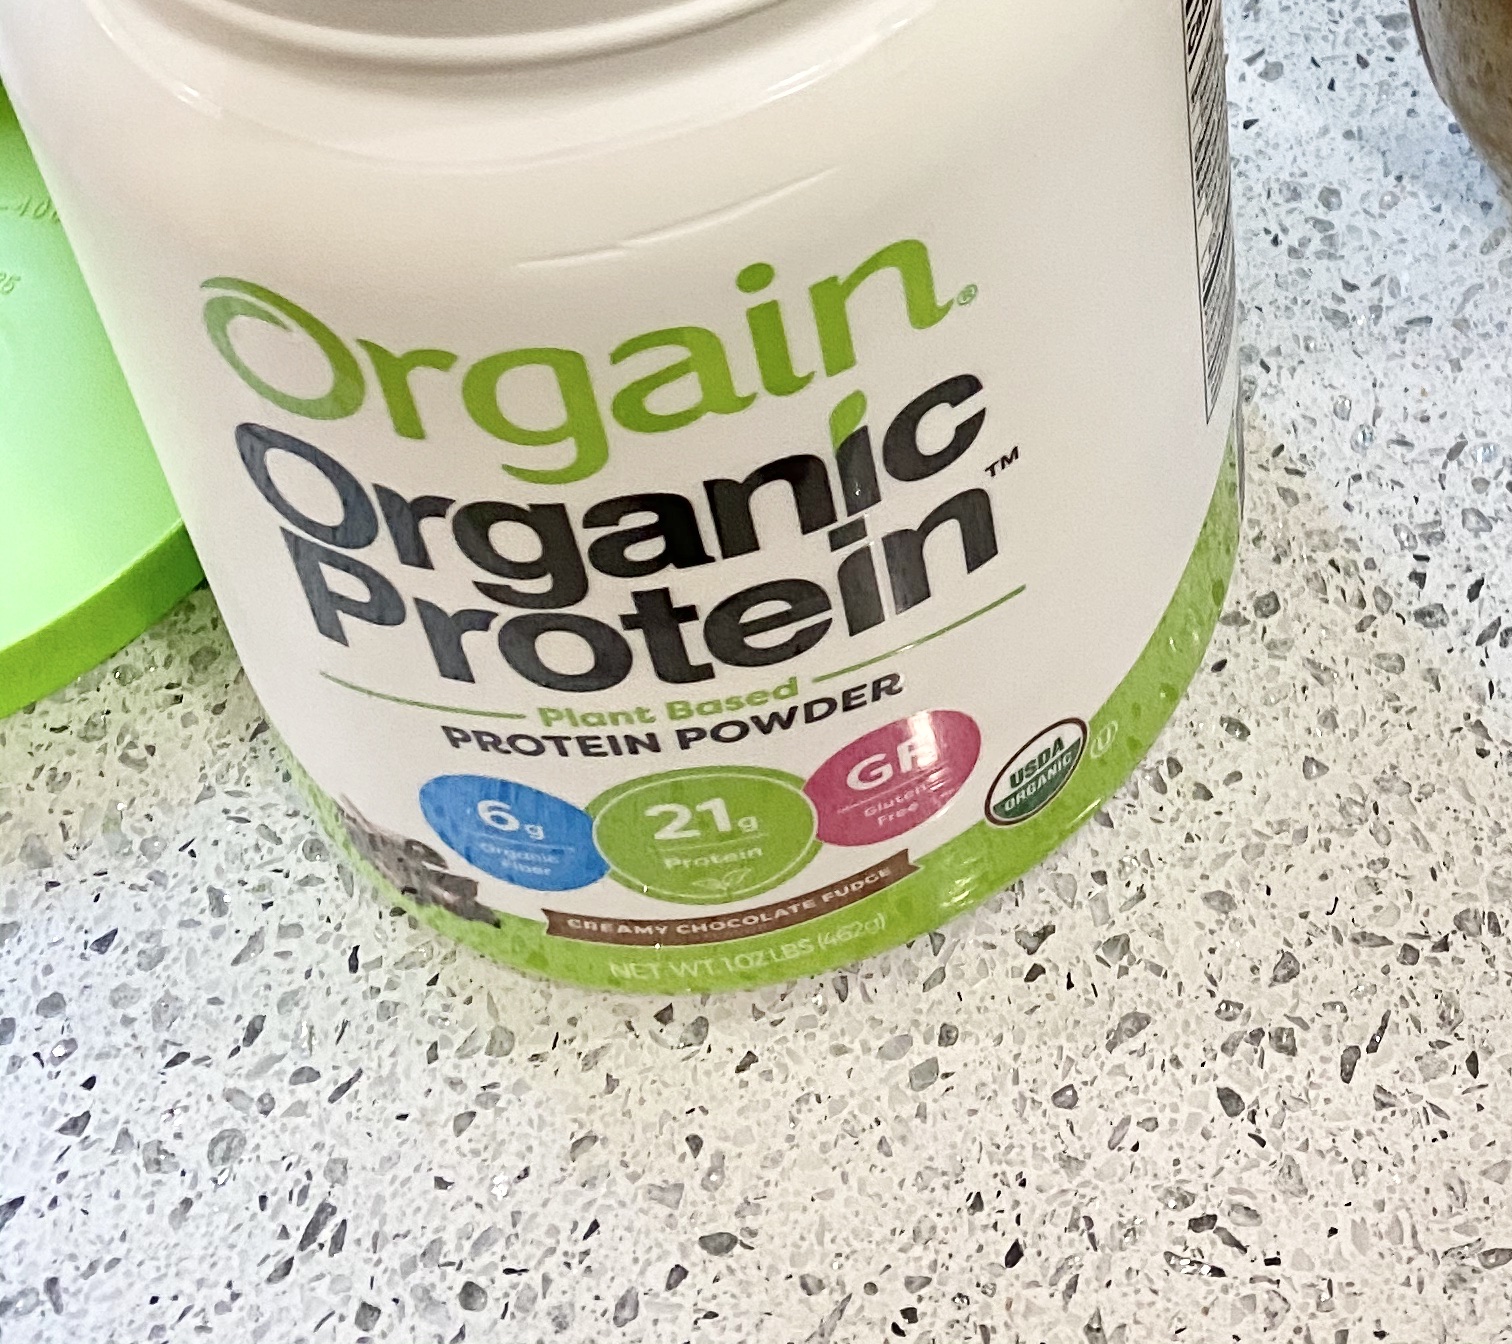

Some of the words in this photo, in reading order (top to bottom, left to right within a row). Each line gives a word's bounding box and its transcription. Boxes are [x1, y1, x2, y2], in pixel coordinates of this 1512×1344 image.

[234, 373, 986, 609] Organic
[280, 488, 998, 693] Protein
[441, 725, 661, 757] PROTEIN
[675, 672, 905, 750] POWDER
[537, 703, 657, 728] Plant
[666, 676, 799, 721] Based
[1004, 751, 1073, 812] ORGANIC
[1009, 736, 1065, 789] USDA
[477, 800, 545, 840] 6g
[644, 797, 759, 840] 21g
[664, 846, 763, 870] Protein
[567, 917, 668, 936] CREAMY
[676, 898, 816, 935] CHOCOLATE
[820, 867, 893, 902] FUDGE
[609, 962, 660, 980] NET
[669, 958, 715, 978] WT
[768, 938, 814, 962] LBS
